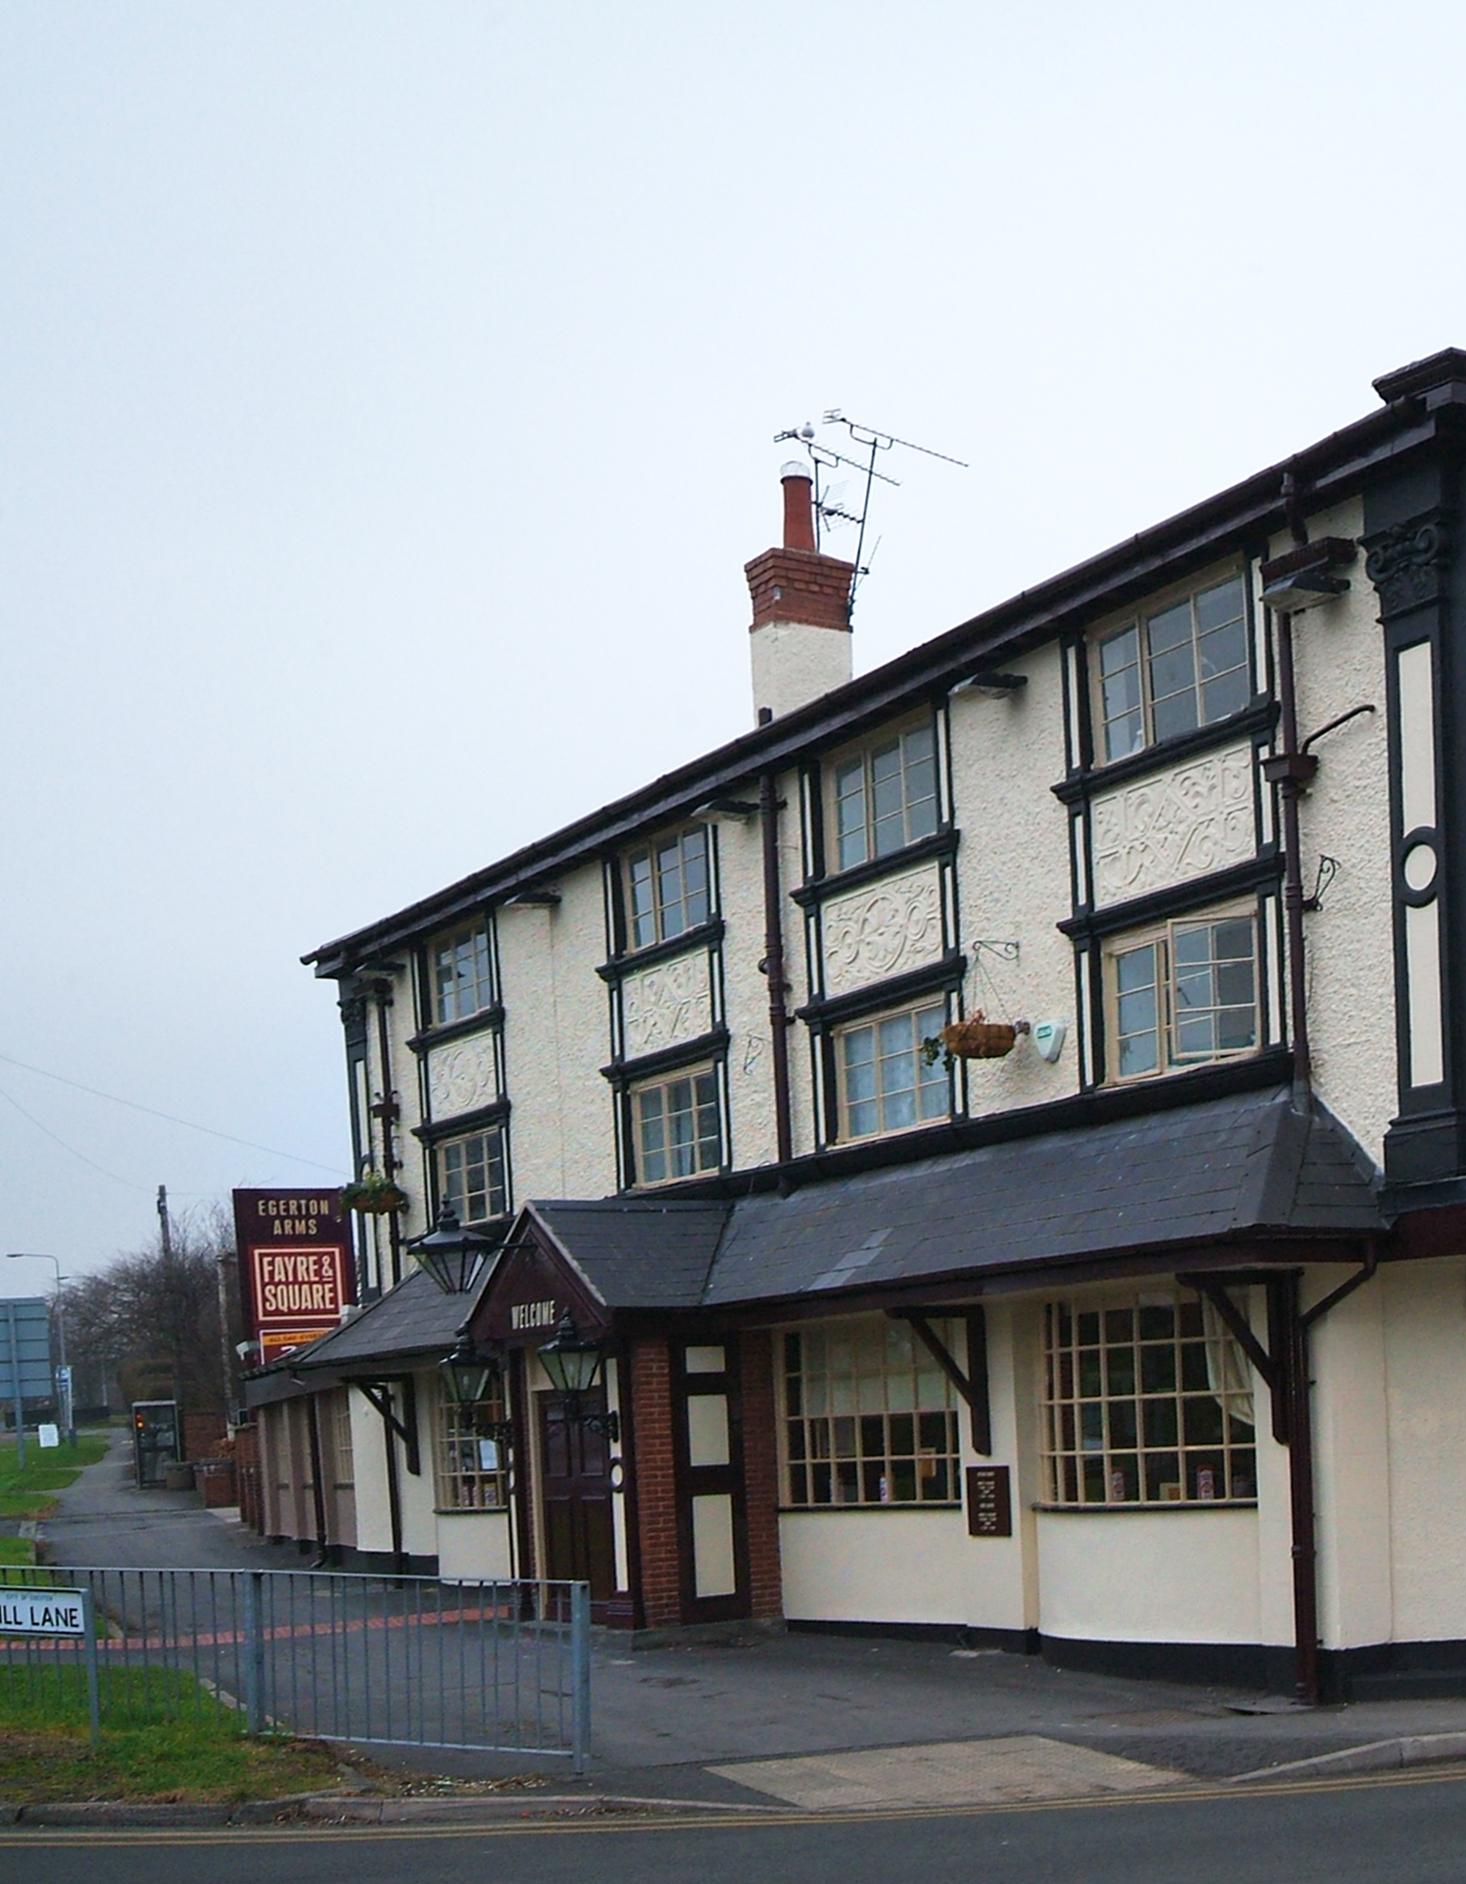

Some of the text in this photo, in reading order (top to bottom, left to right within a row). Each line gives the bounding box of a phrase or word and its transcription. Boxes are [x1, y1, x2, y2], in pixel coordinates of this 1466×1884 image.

[258, 1200, 329, 1216] EGERTON
[273, 1219, 318, 1236] ARMS
[262, 1255, 333, 1283] FAYRE &
[264, 1284, 335, 1312] SQUARE
[511, 1300, 555, 1330] WELCOME
[30, 1605, 79, 1628] LANE
